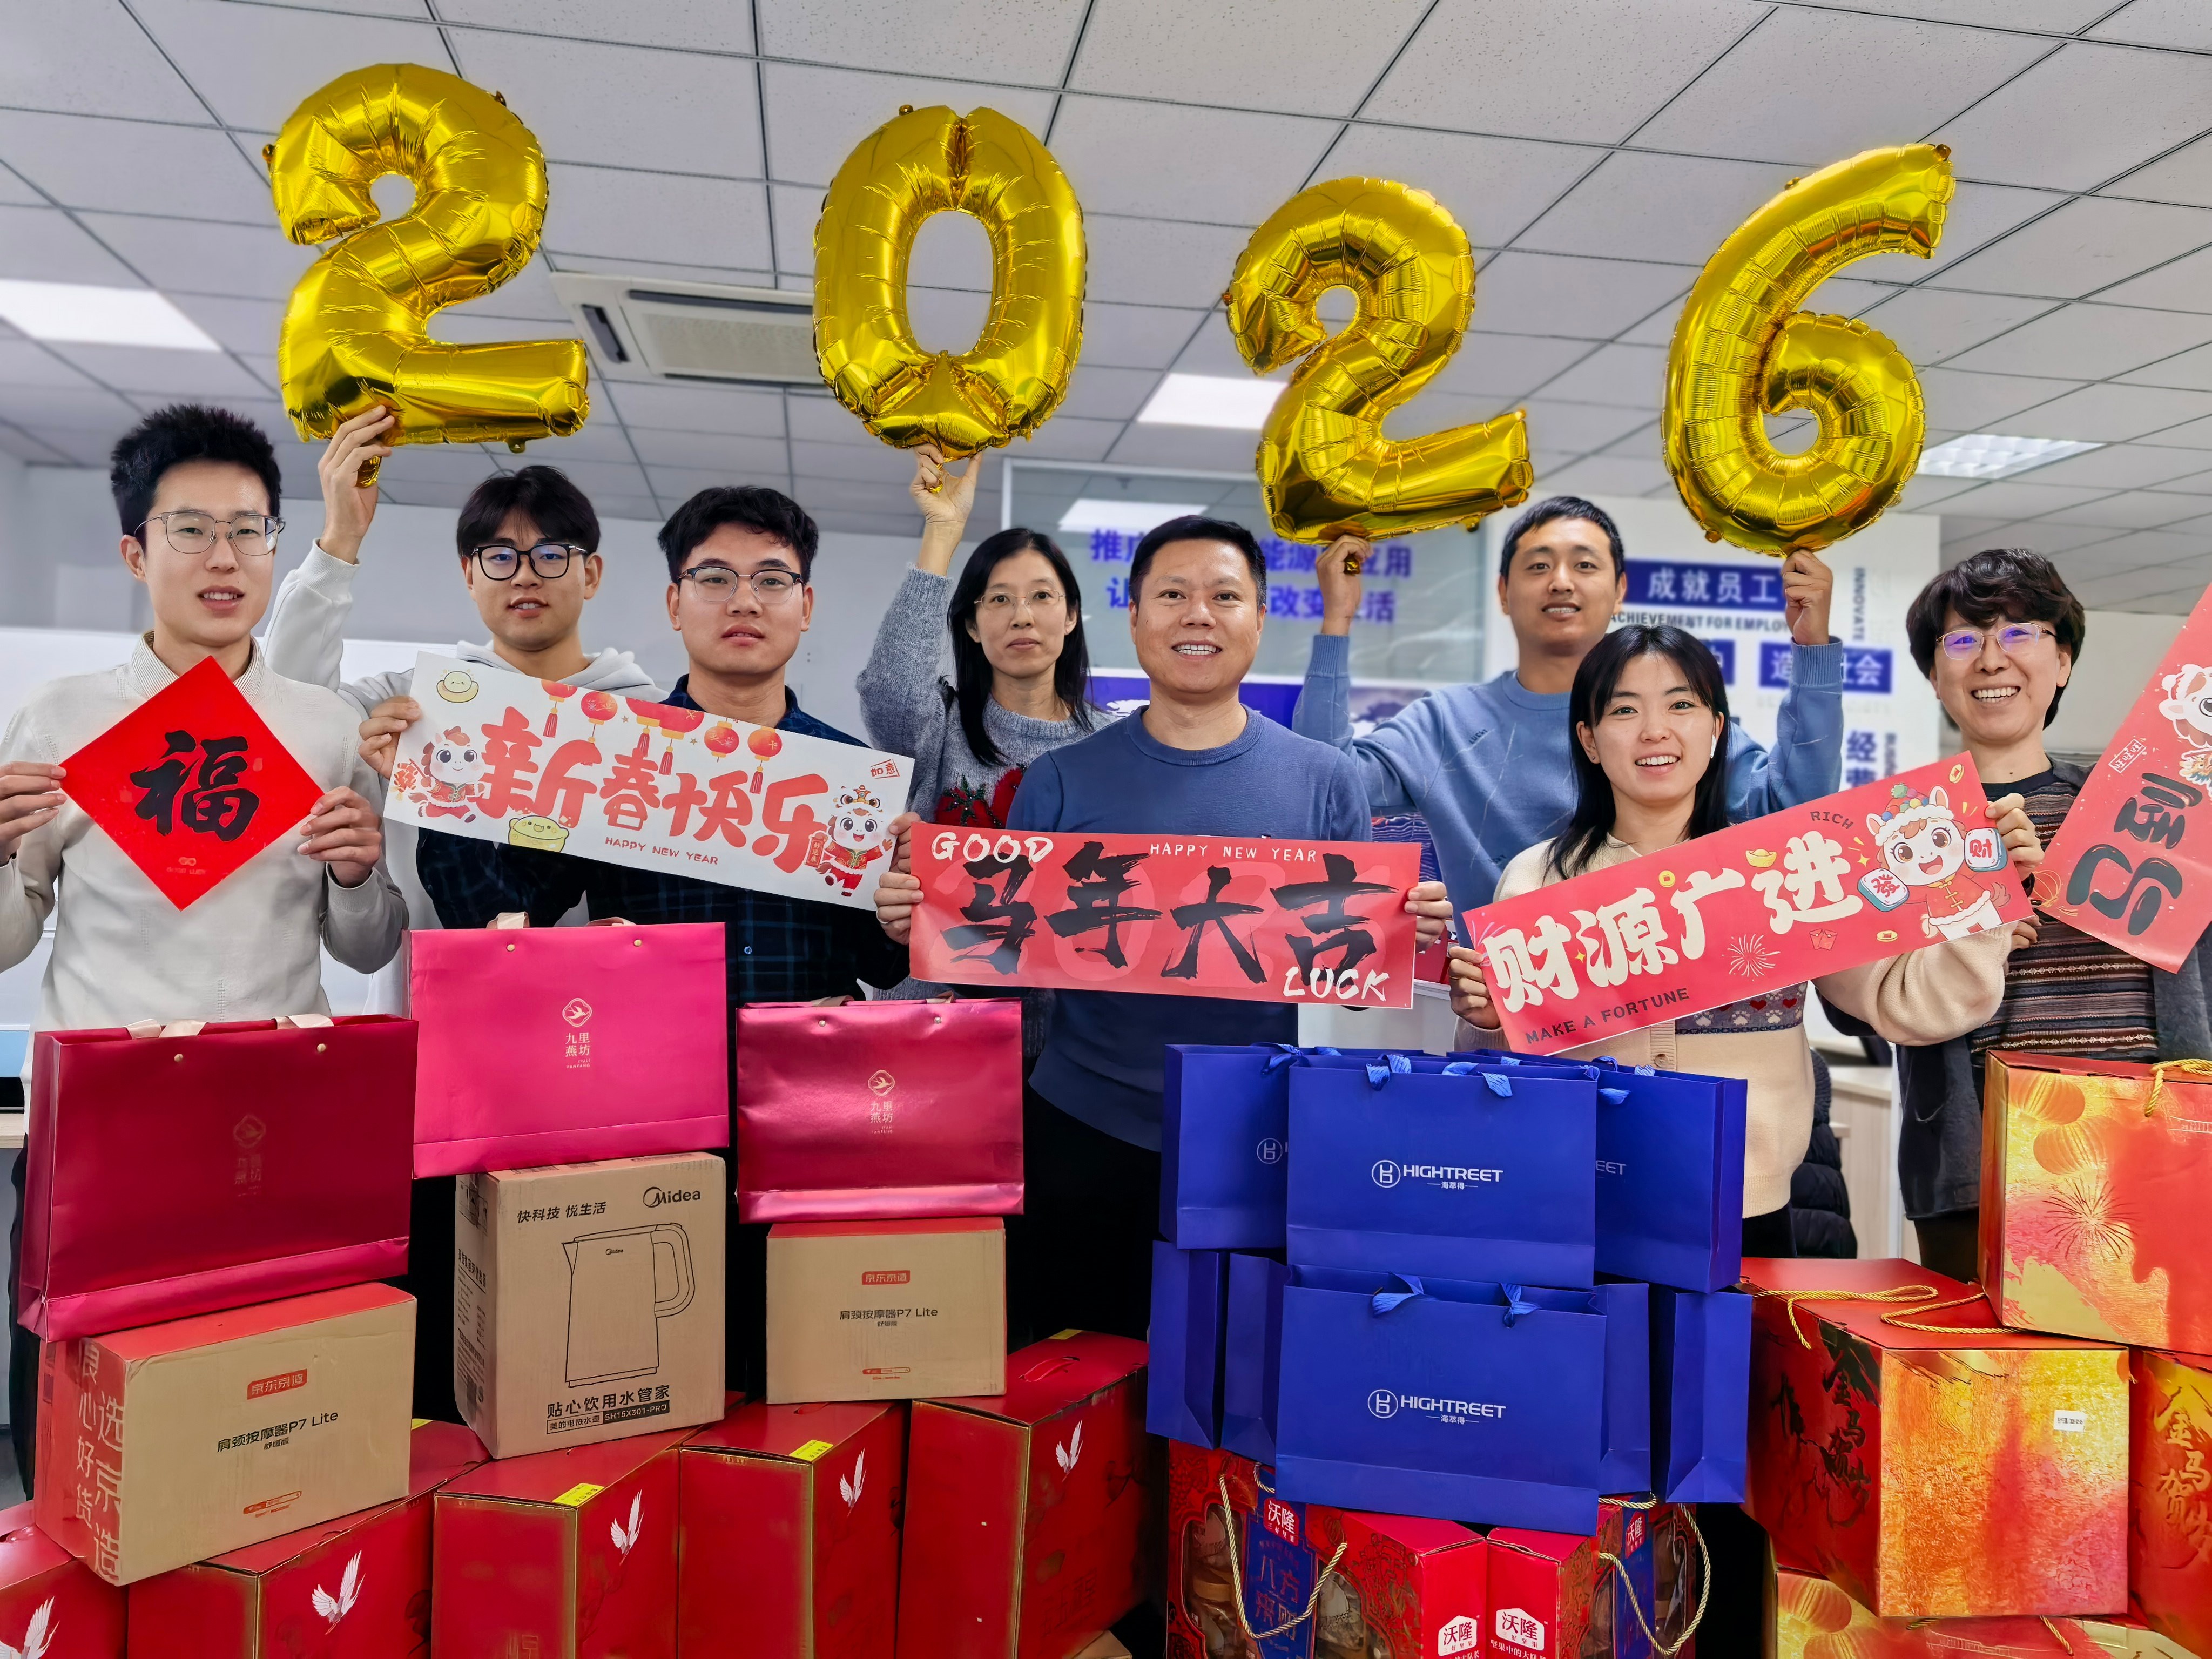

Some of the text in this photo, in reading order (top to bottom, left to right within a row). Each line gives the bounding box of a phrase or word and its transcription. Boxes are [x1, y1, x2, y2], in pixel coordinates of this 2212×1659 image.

[1648, 567, 1777, 603] 成就员工
[1853, 567, 1865, 640] INNOVATE
[1706, 616, 1732, 629] FOR
[130, 730, 260, 842] 福
[478, 706, 829, 873] 新春快乐
[1810, 810, 1853, 829] RICH
[605, 837, 718, 865] HAPPY NEW YEAR
[931, 831, 1055, 863] GOOD
[1149, 843, 1317, 862] HAPPY NEW YEAR
[1968, 838, 1993, 860] 财
[939, 840, 1400, 984] 马年大吉
[1483, 830, 1863, 1013] 财源广进
[1283, 966, 1390, 1001] LUCK
[1526, 987, 1690, 1044] MAKE A FORTUNE
[1403, 1165, 1503, 1182] HIGHTREET
[643, 1186, 701, 1208] Midea
[517, 1201, 606, 1224] 快科技 悦生活
[916, 1307, 938, 1317] Lite
[252, 1373, 304, 1395] 京东京造
[547, 1385, 670, 1419] 贴心饮用水管家
[604, 1404, 667, 1421] SH15X301-PRO
[1401, 1395, 1506, 1418] HIGHTREET
[217, 1412, 338, 1453] 肩颈按摩器P7 Lite
[1268, 1500, 1295, 1534] 沃隆
[1444, 1622, 1472, 1645] 沃隆
[1502, 1611, 1537, 1641] 沃隆
